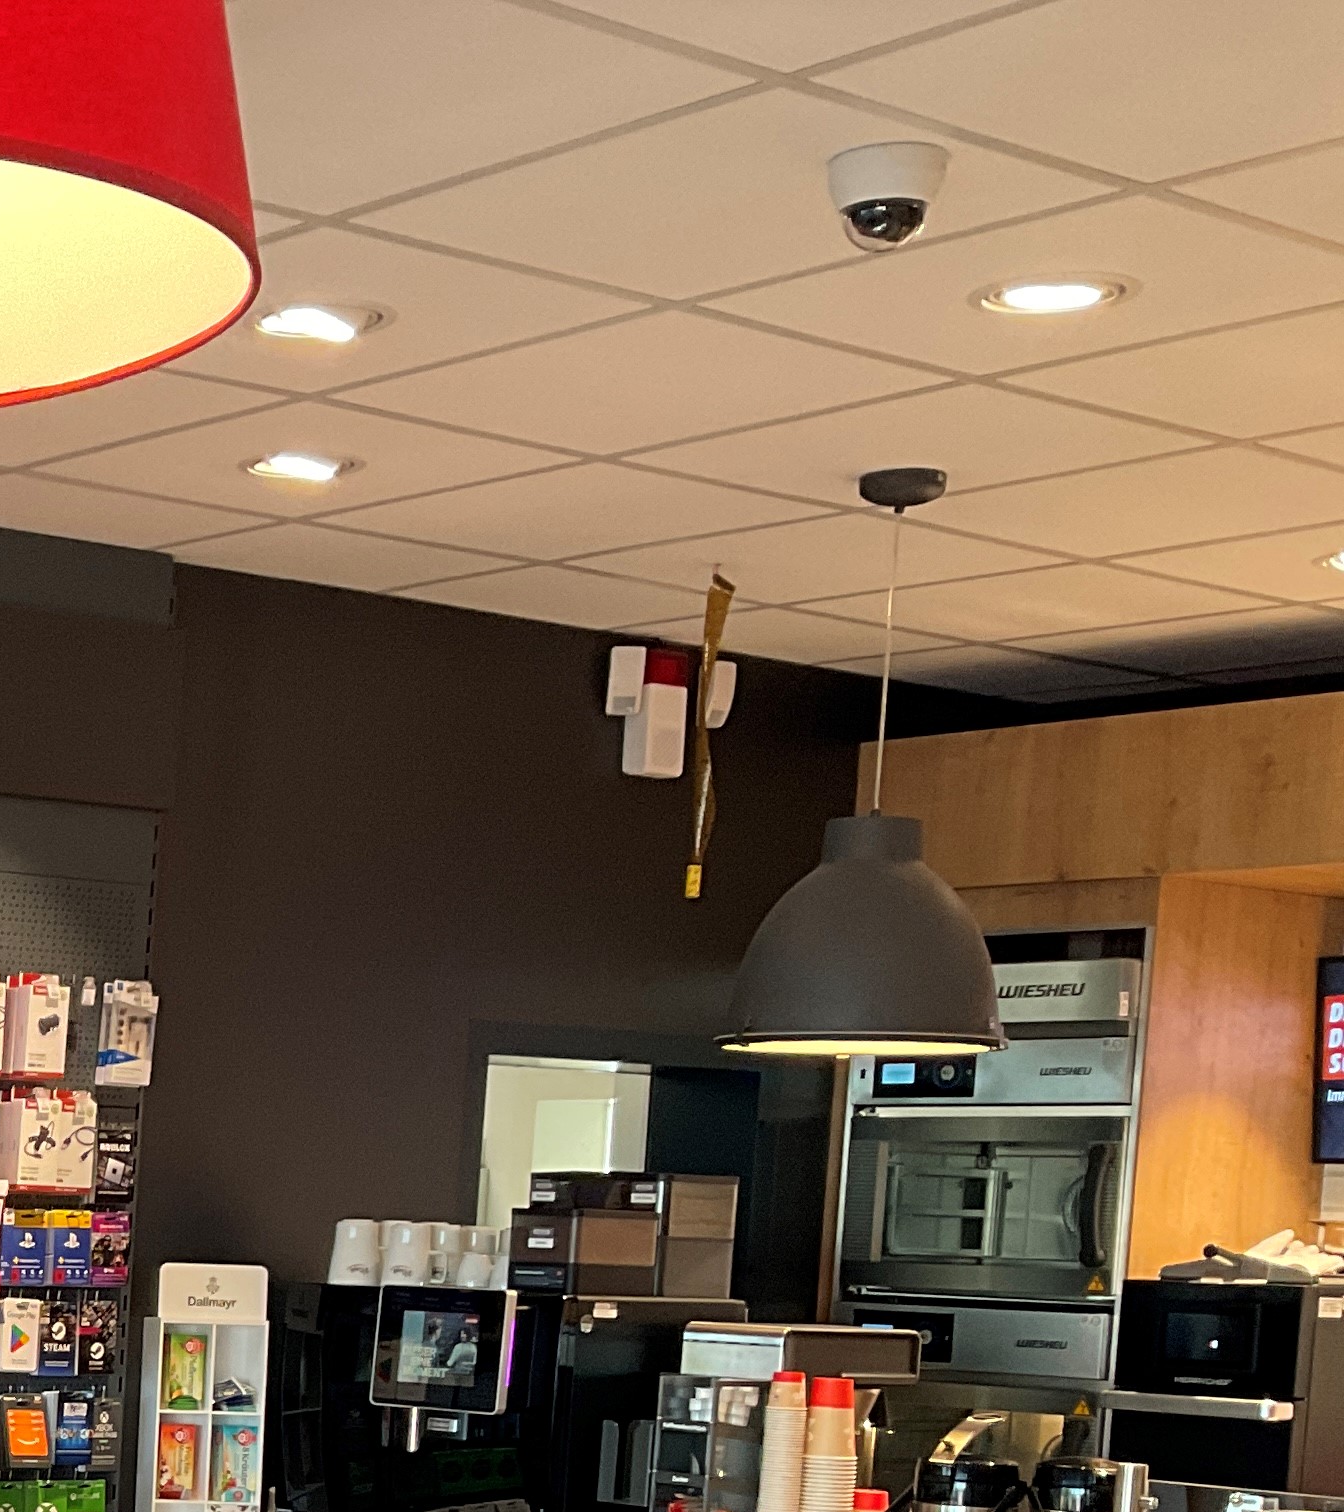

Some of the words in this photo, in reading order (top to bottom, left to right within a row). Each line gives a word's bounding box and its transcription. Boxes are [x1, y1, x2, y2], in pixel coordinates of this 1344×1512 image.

[998, 982, 1086, 999] WIESHEU
[1039, 1067, 1092, 1077] WIESHEU
[187, 1295, 237, 1309] Dallmayr
[43, 1343, 71, 1352] STEAM
[1015, 1339, 1068, 1350] WIESHEU
